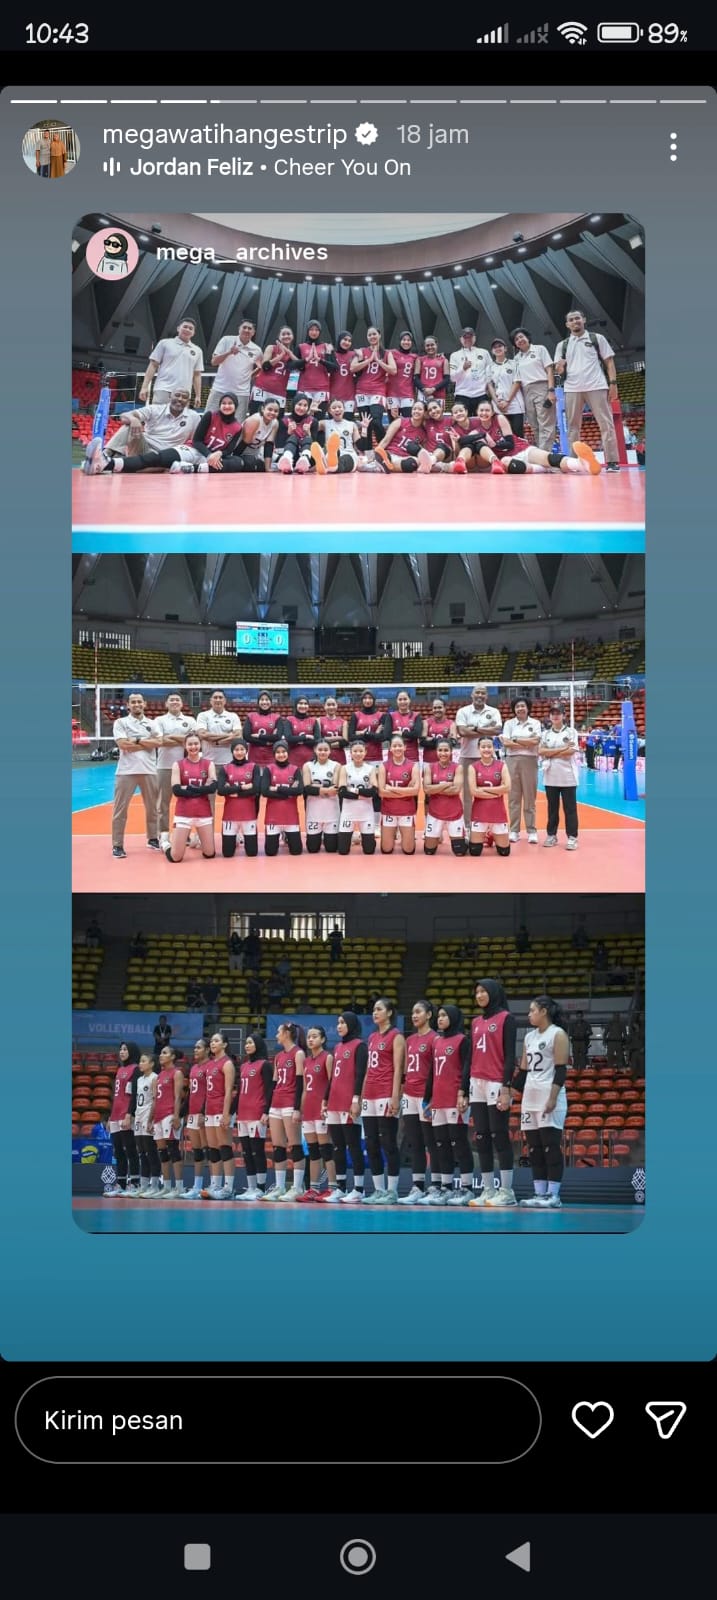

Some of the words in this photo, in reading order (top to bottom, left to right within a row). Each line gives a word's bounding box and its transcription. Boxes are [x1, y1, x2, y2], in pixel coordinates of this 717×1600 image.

[25, 23, 89, 44] 10:43
[103, 122, 348, 150] megawatihangestrip
[397, 124, 421, 144] 18
[426, 123, 470, 150] jam
[130, 157, 202, 176] Jordan
[207, 157, 254, 176] Feliz
[274, 158, 336, 176] Cheer
[340, 158, 378, 176] You
[384, 158, 411, 176] On
[339, 363, 348, 377] 6
[367, 362, 380, 374] 18
[405, 361, 413, 374] 8
[424, 366, 437, 380] 19
[207, 435, 225, 452] 17
[435, 432, 445, 444] 5
[308, 821, 319, 831] 22
[427, 823, 433, 833] 5
[88, 1023, 153, 1035] VOLLEYBALL
[476, 1033, 486, 1053] 4
[334, 1059, 342, 1078] 6
[407, 1053, 420, 1073] 21
[434, 1055, 447, 1077] 17
[526, 1051, 544, 1073] 22
[157, 1083, 163, 1099] 5
[241, 1077, 249, 1095] 11
[306, 1074, 313, 1091] 2
[44, 1409, 103, 1431] Kirim
[112, 1414, 184, 1436] pesan
